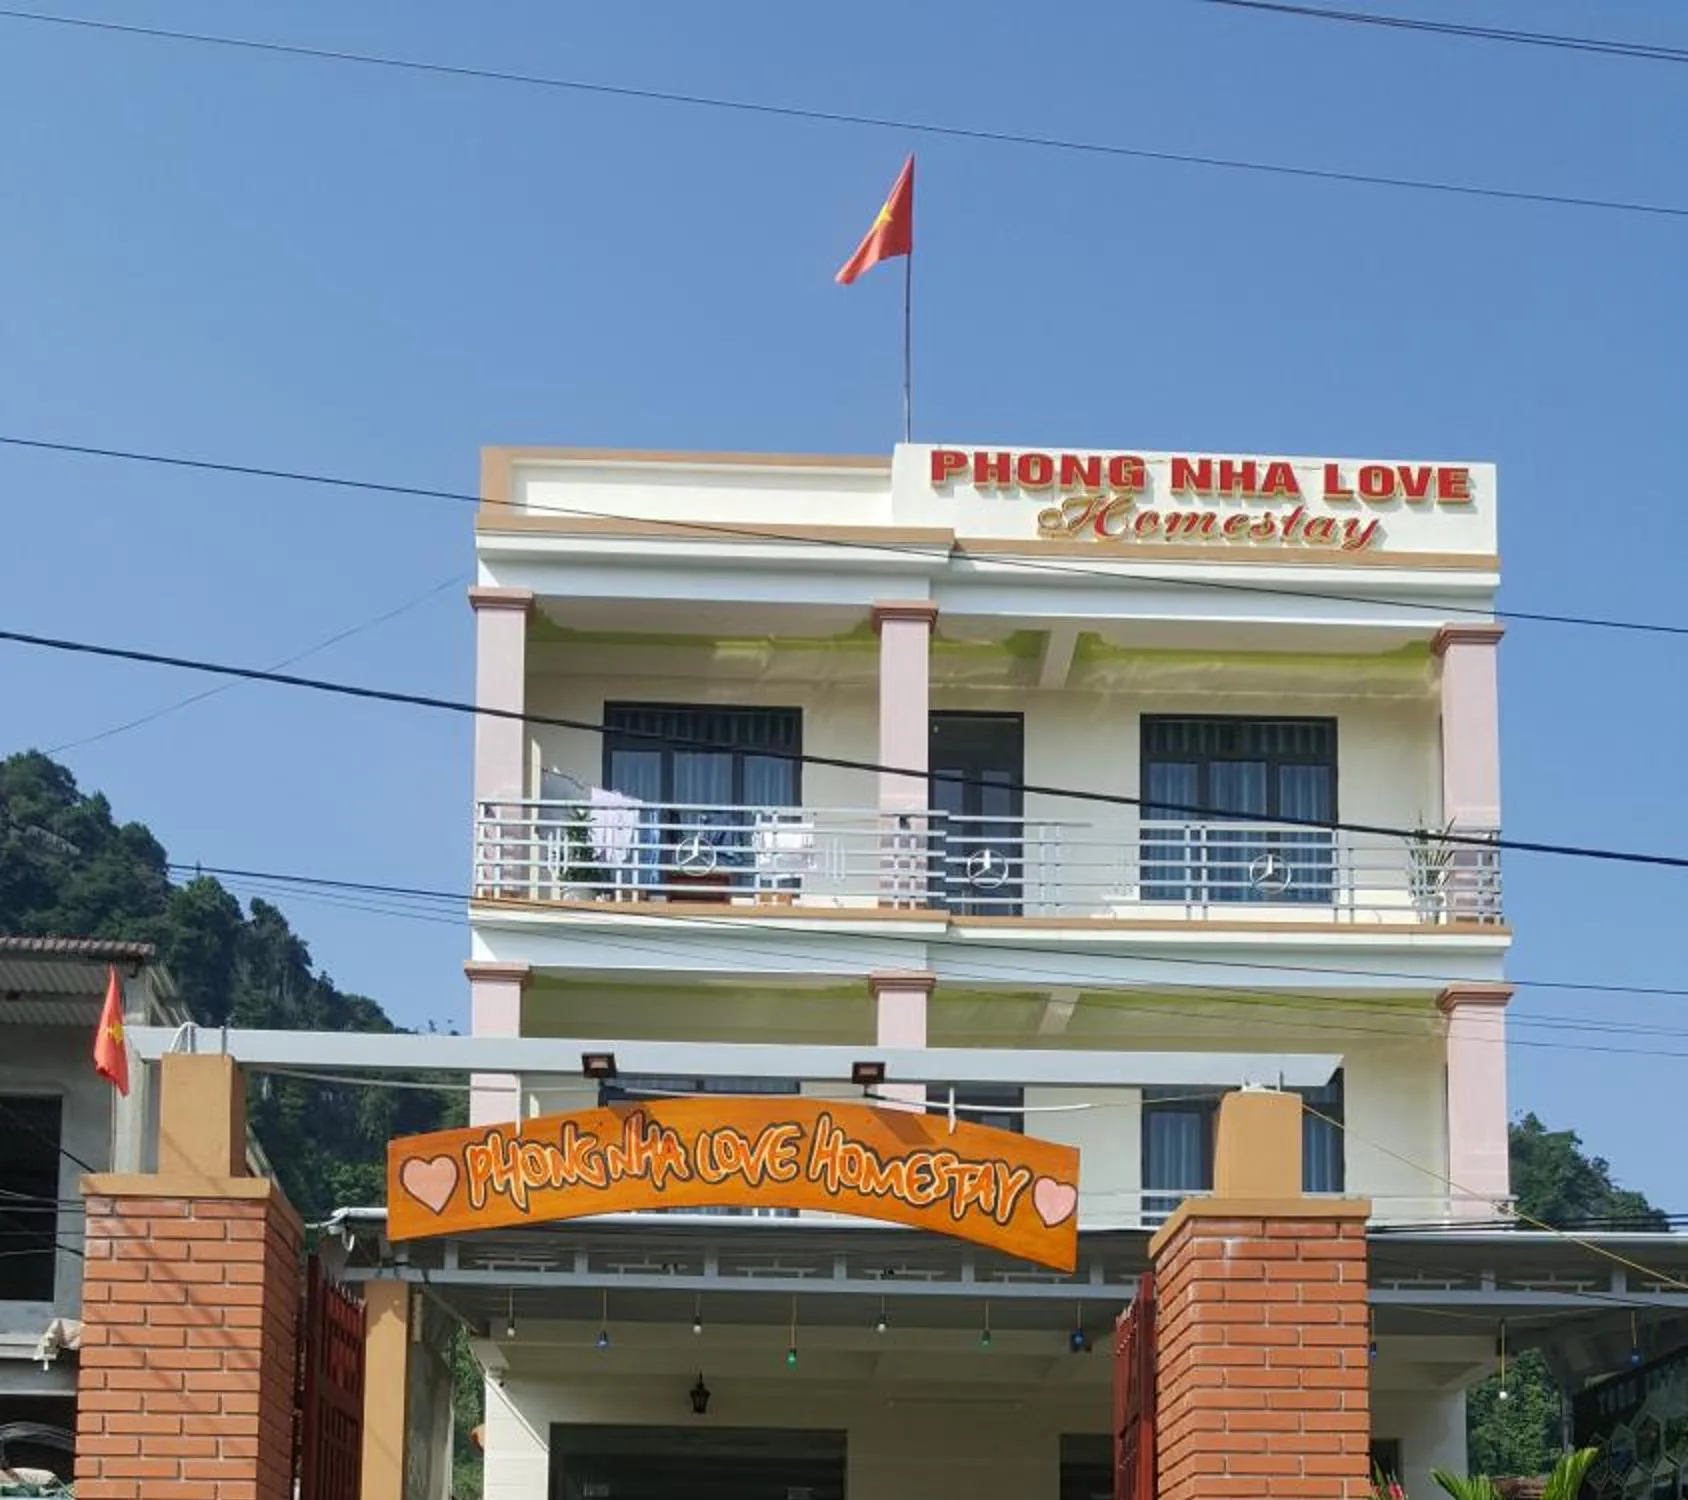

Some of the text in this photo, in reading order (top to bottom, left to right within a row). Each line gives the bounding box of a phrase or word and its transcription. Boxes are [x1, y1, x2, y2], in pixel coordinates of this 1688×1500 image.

[930, 449, 1472, 503] PHONG NHA LOVE
[1037, 495, 1384, 552] Homestay
[463, 1109, 1033, 1225] PHONG NHA LOVE HOMESTAY
